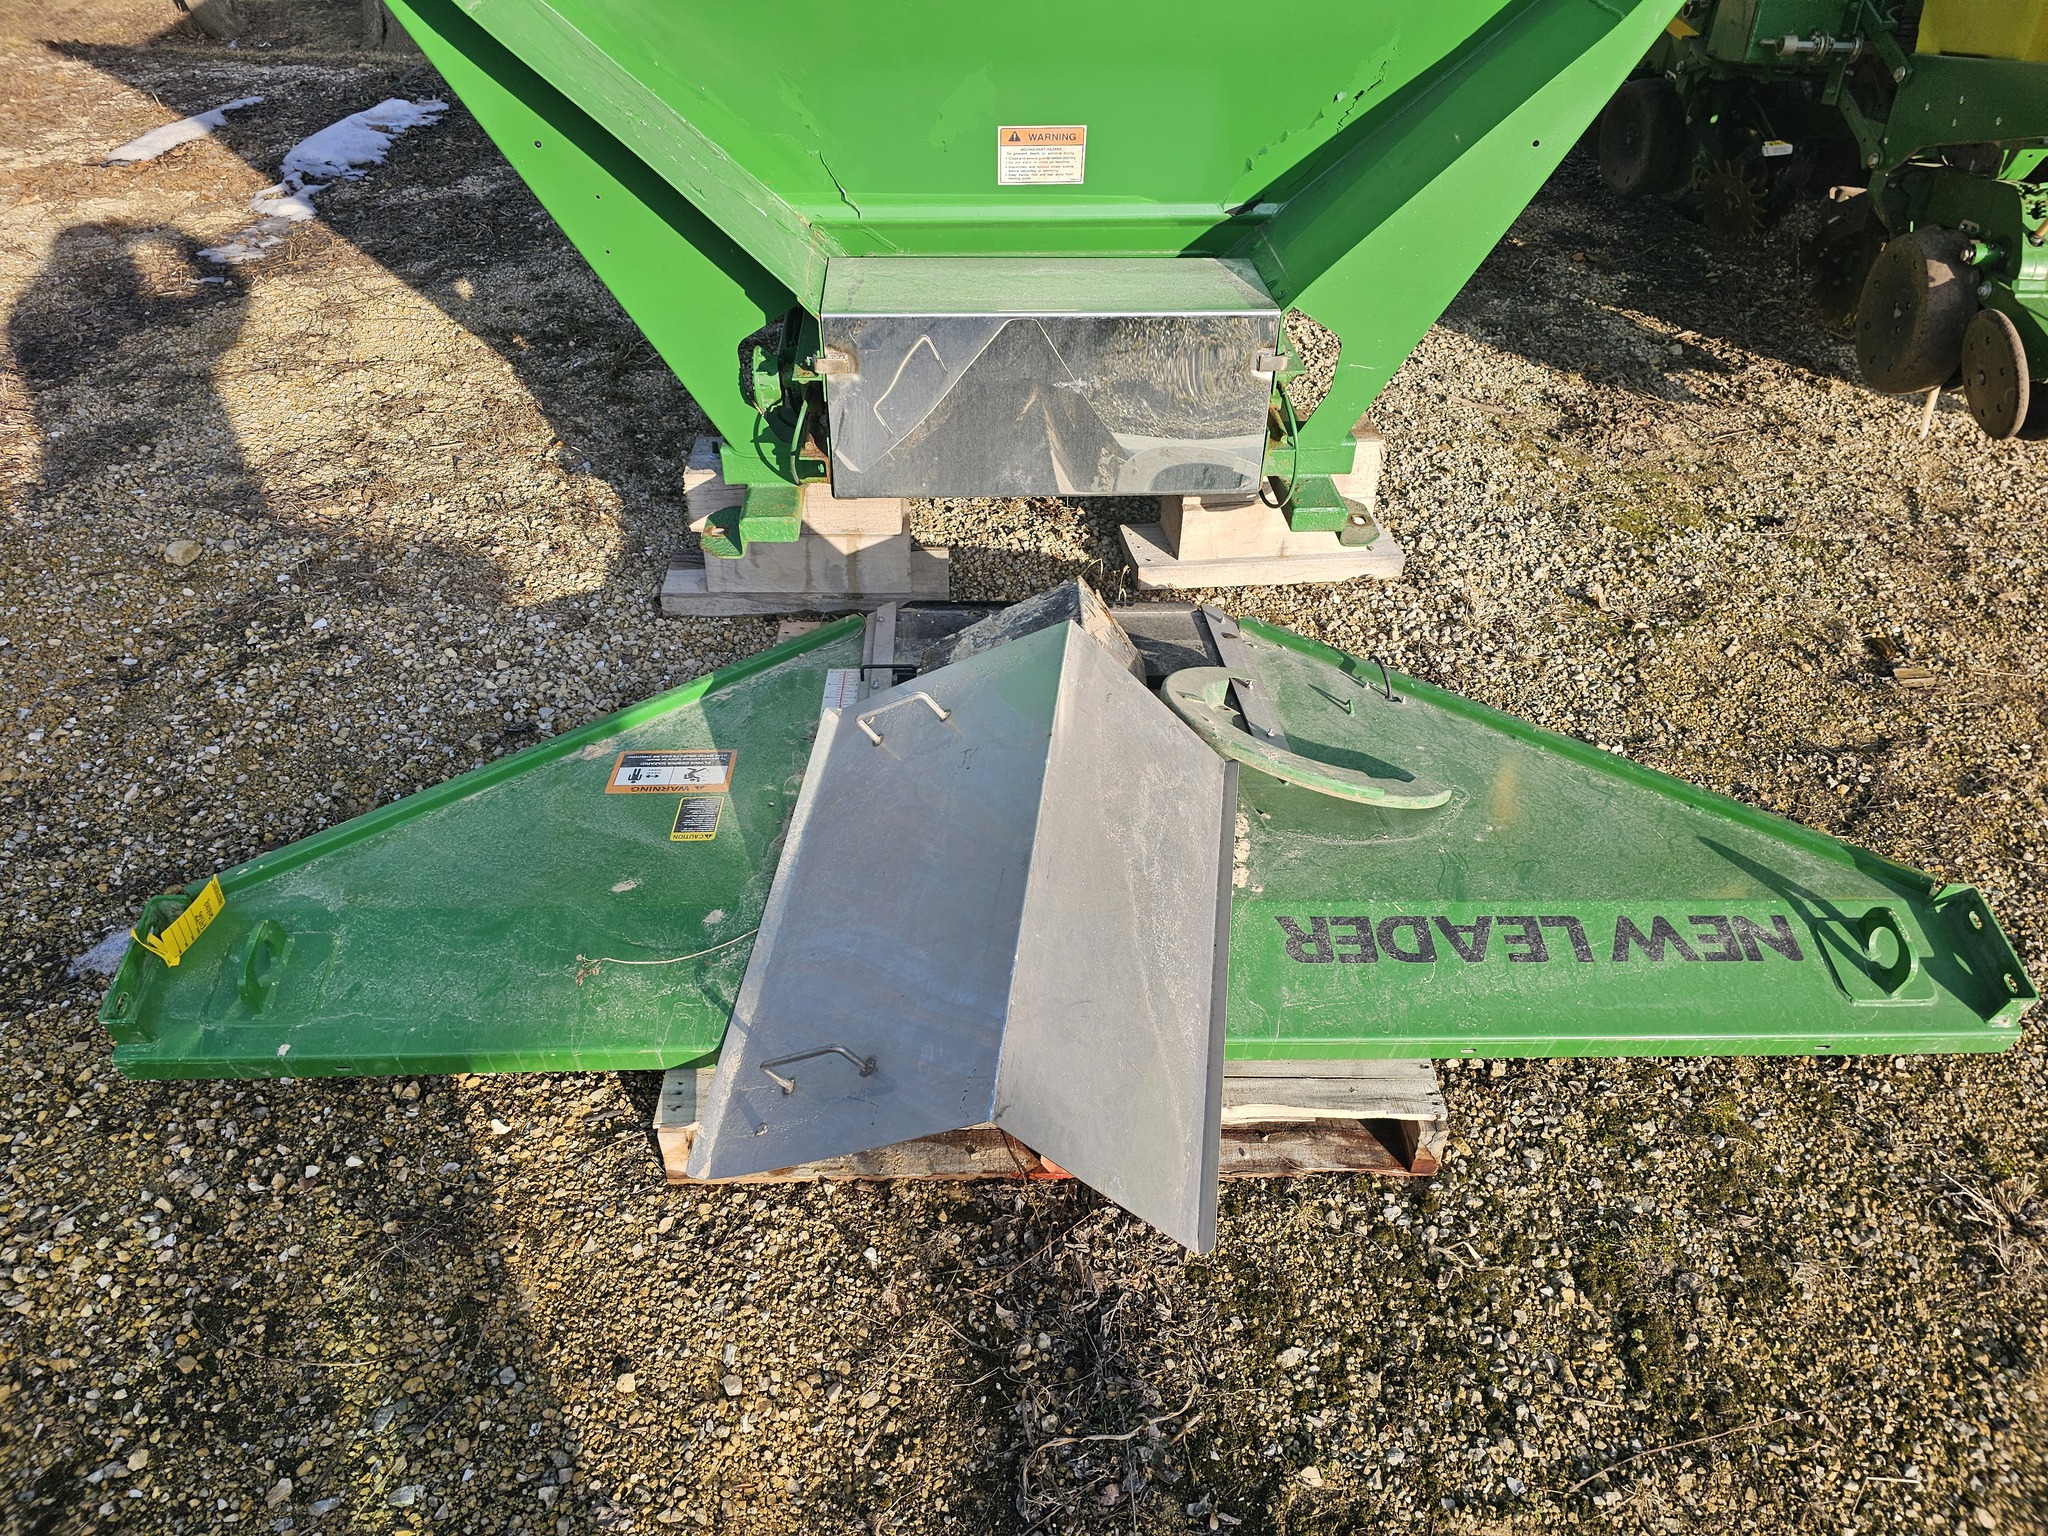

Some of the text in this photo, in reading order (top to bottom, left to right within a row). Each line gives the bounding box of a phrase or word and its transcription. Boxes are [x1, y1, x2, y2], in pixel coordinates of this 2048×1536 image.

[1028, 133, 1077, 141] WARNING
[1274, 915, 1804, 963] NEW LEADER
